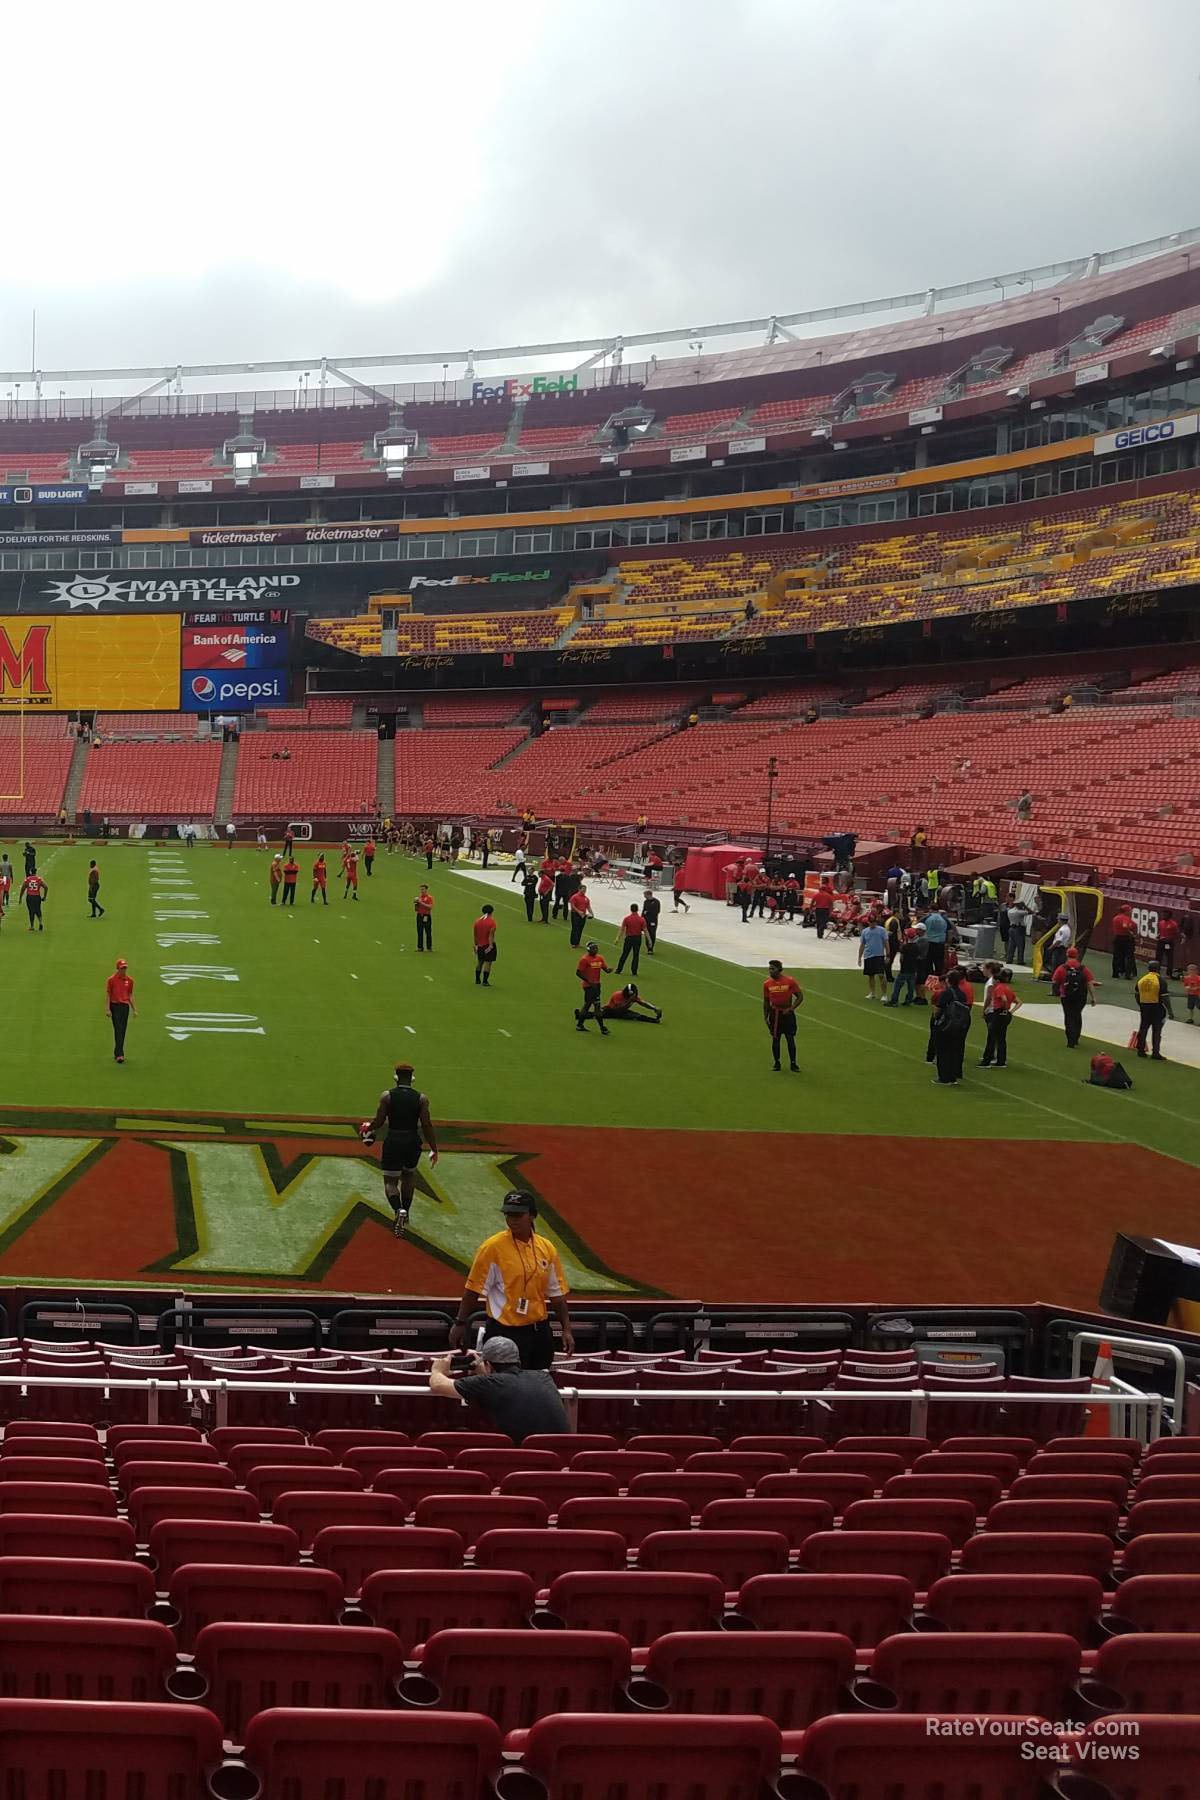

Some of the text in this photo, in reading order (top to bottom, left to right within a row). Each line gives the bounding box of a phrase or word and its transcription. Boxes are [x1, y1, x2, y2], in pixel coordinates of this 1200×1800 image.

[472, 374, 578, 399] FedExField
[1115, 421, 1174, 449] GEICO
[38, 490, 83, 499] BUD LIGHT
[39, 535, 53, 543] FOR
[71, 534, 111, 542] REDSKINS.
[202, 530, 277, 544] ticketmaster
[306, 527, 383, 541] ticketmaster
[130, 575, 300, 591] MARYLAND
[409, 570, 550, 589] FedExField
[128, 587, 267, 602] LOTTERY
[193, 633, 276, 645] Bank of America
[220, 679, 278, 701] pepsi
[1130, 907, 1159, 940] 983
